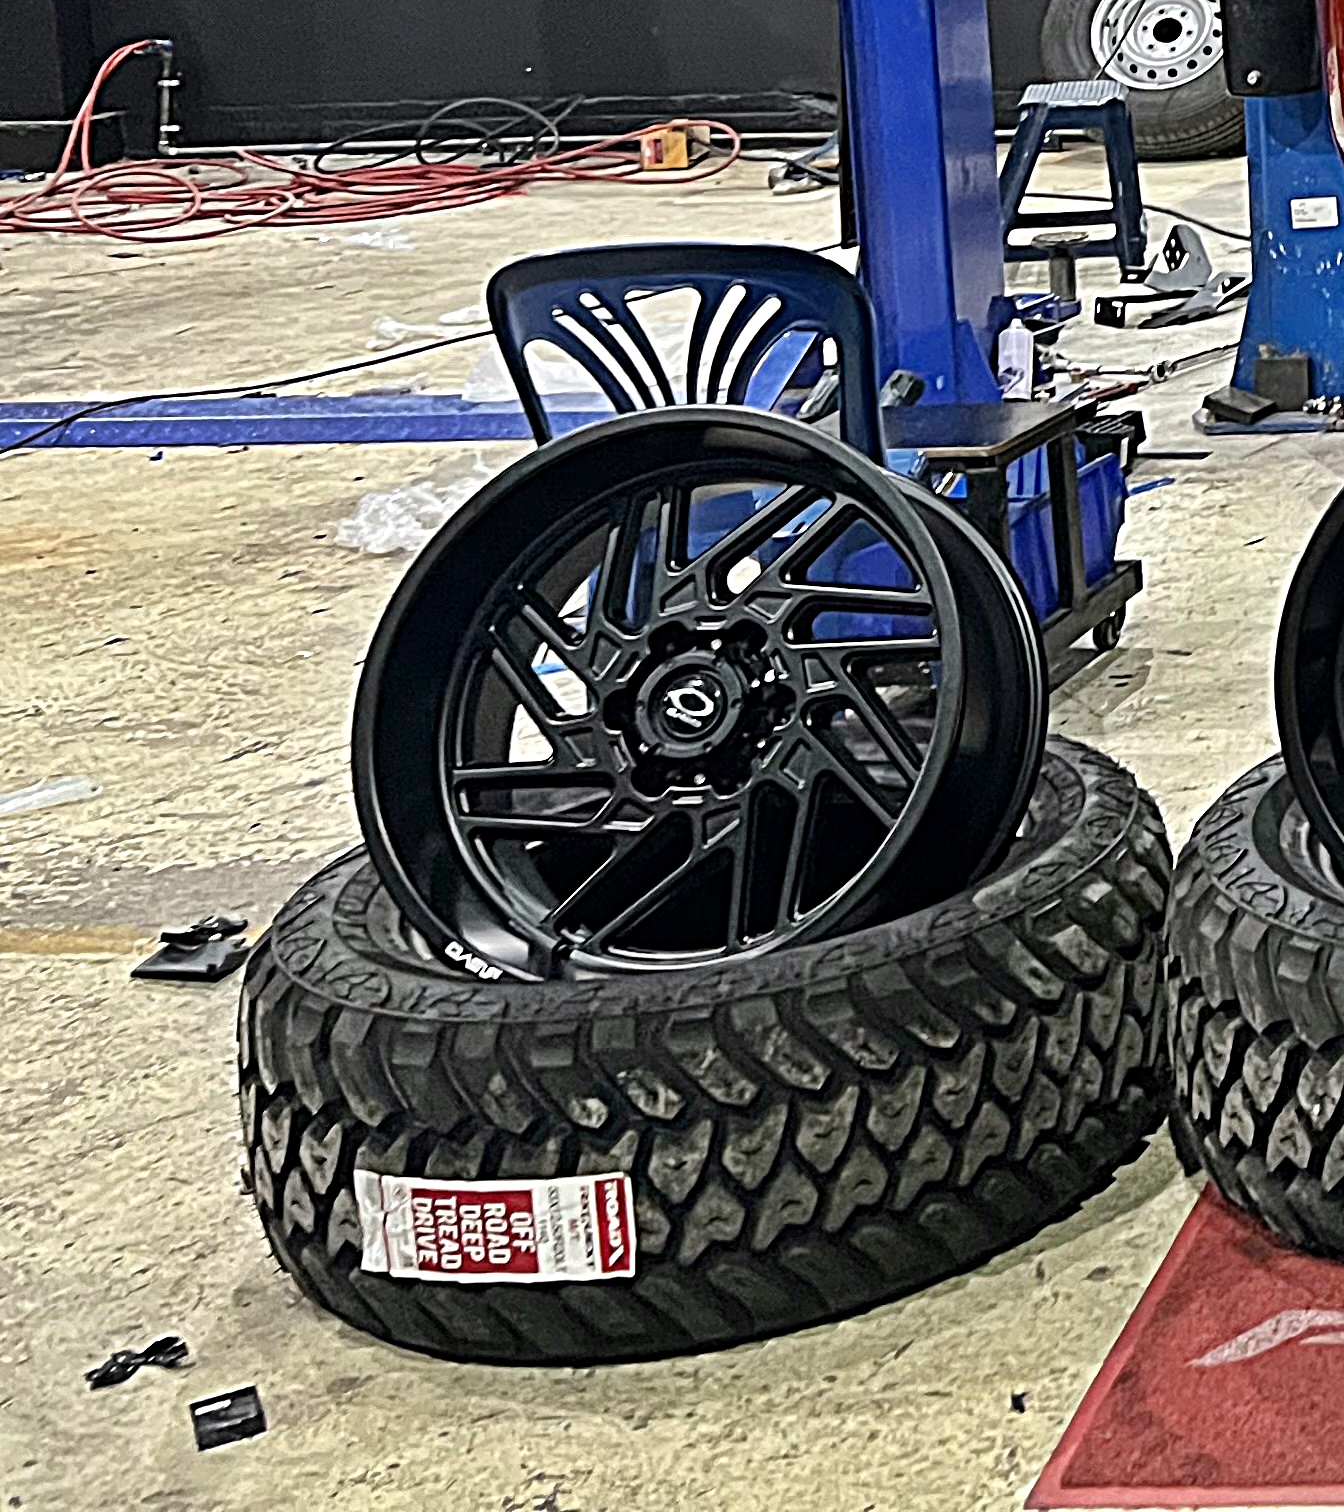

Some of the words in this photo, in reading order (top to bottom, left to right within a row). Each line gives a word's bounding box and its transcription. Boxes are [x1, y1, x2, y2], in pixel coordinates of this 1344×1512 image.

[411, 1196, 439, 1265] DRIVE
[433, 1195, 462, 1270] TREAD
[459, 1203, 486, 1263] DEEP
[483, 1201, 511, 1265] ROAD
[509, 1210, 536, 1254] OFF
